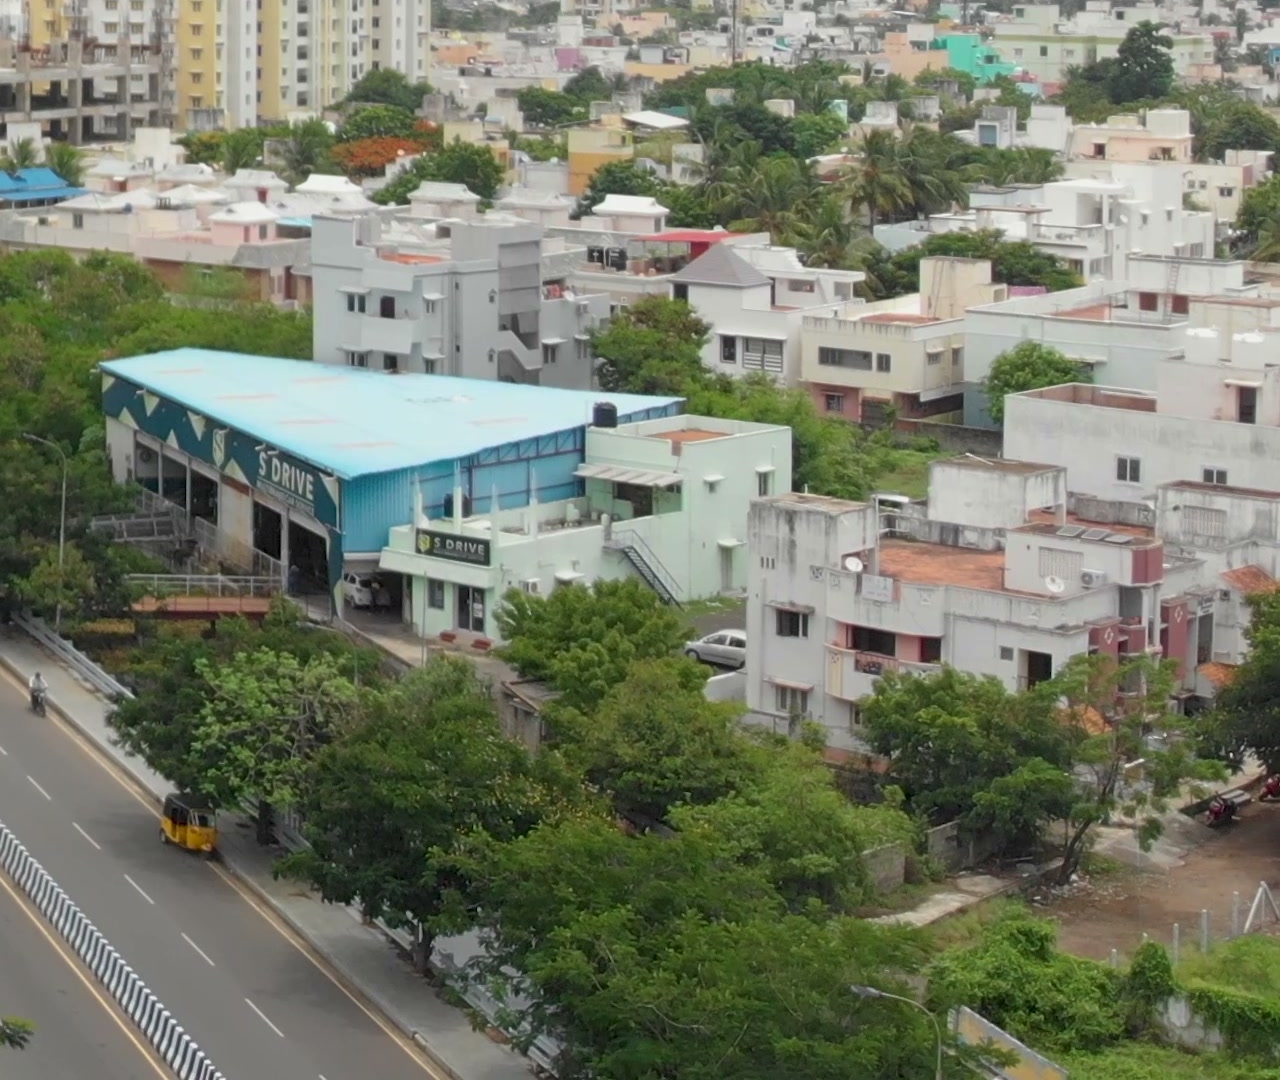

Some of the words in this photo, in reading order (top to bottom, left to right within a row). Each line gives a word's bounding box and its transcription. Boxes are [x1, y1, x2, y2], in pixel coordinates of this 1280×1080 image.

[259, 451, 267, 475] S
[271, 457, 314, 500] DRIVE
[434, 537, 440, 548] S
[446, 539, 484, 555] DRIVE
